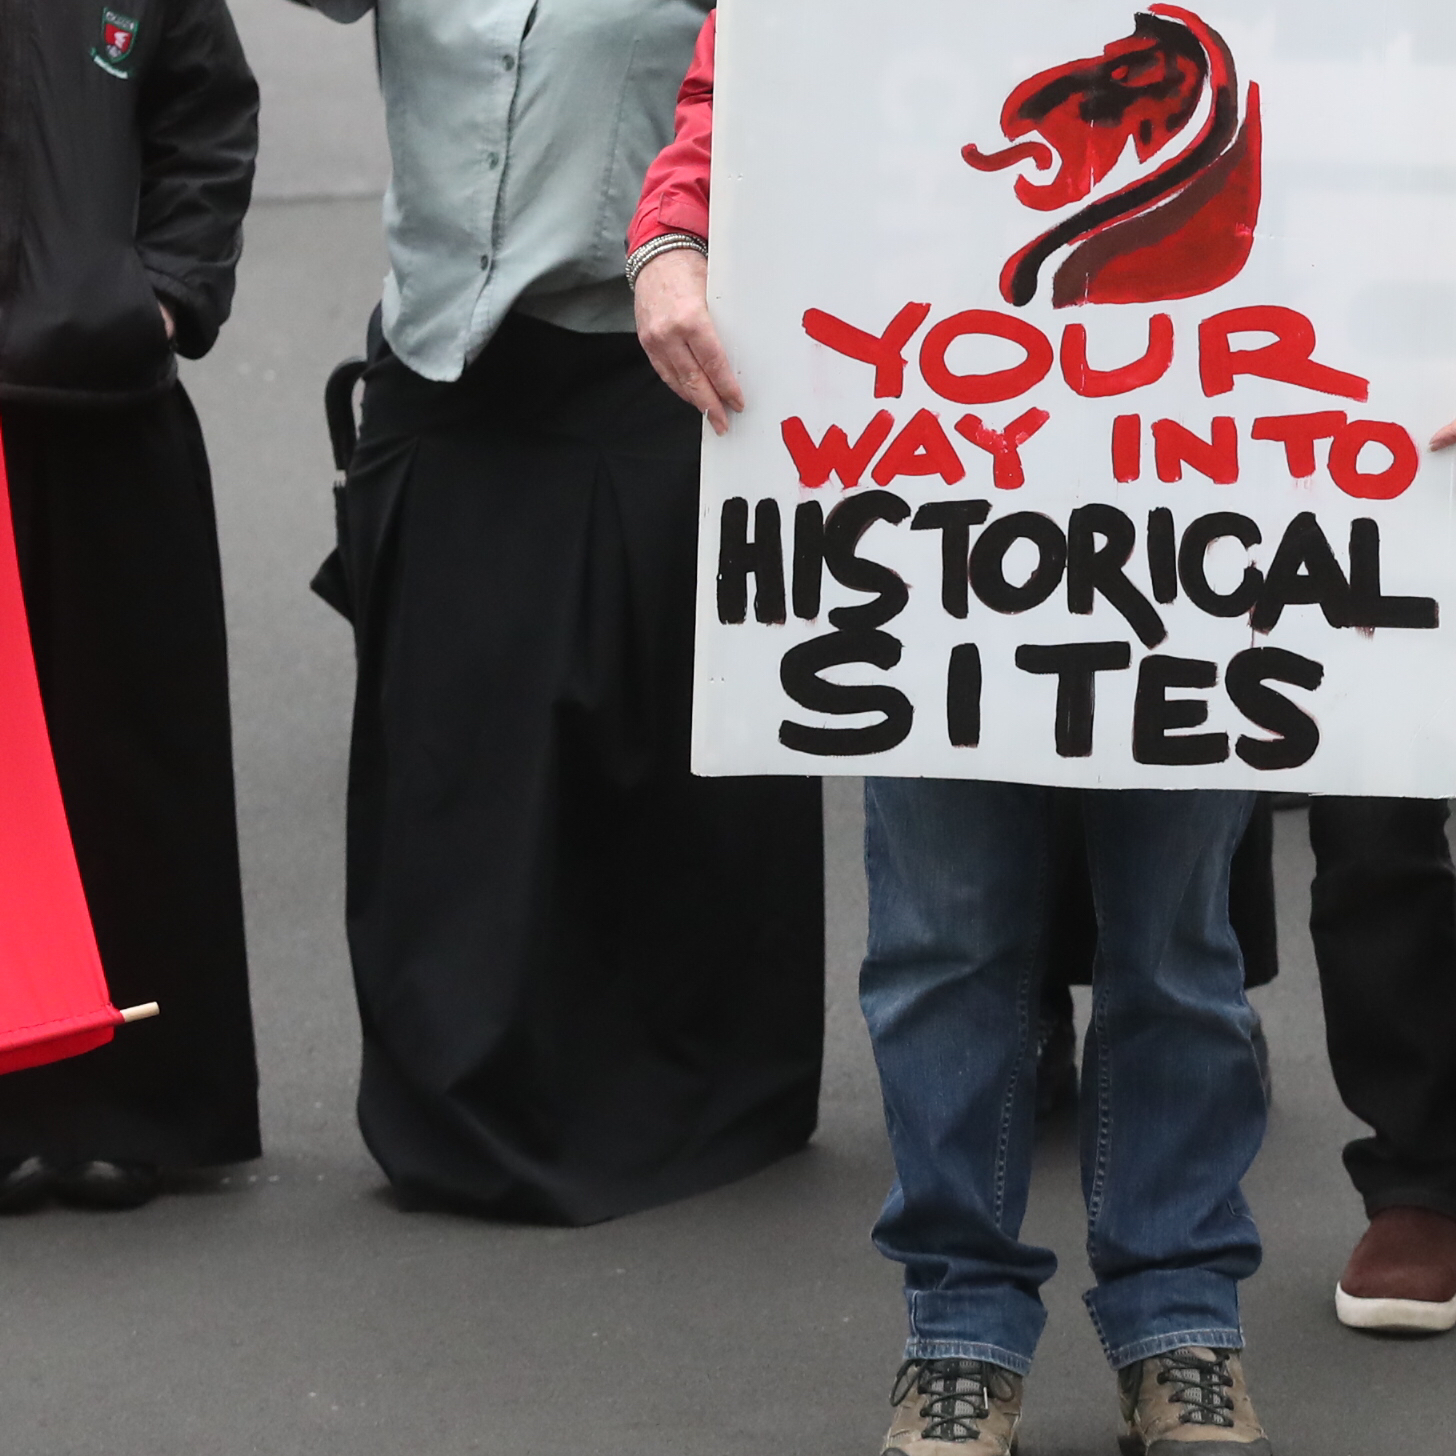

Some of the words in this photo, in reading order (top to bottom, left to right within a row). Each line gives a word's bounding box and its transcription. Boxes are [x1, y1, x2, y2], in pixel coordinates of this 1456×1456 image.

[803, 302, 1370, 404] YOUR
[781, 406, 1049, 491] WAY
[1112, 414, 1420, 500] INTO
[717, 490, 1440, 649] HISTORICAL
[778, 629, 1325, 771] SITES
